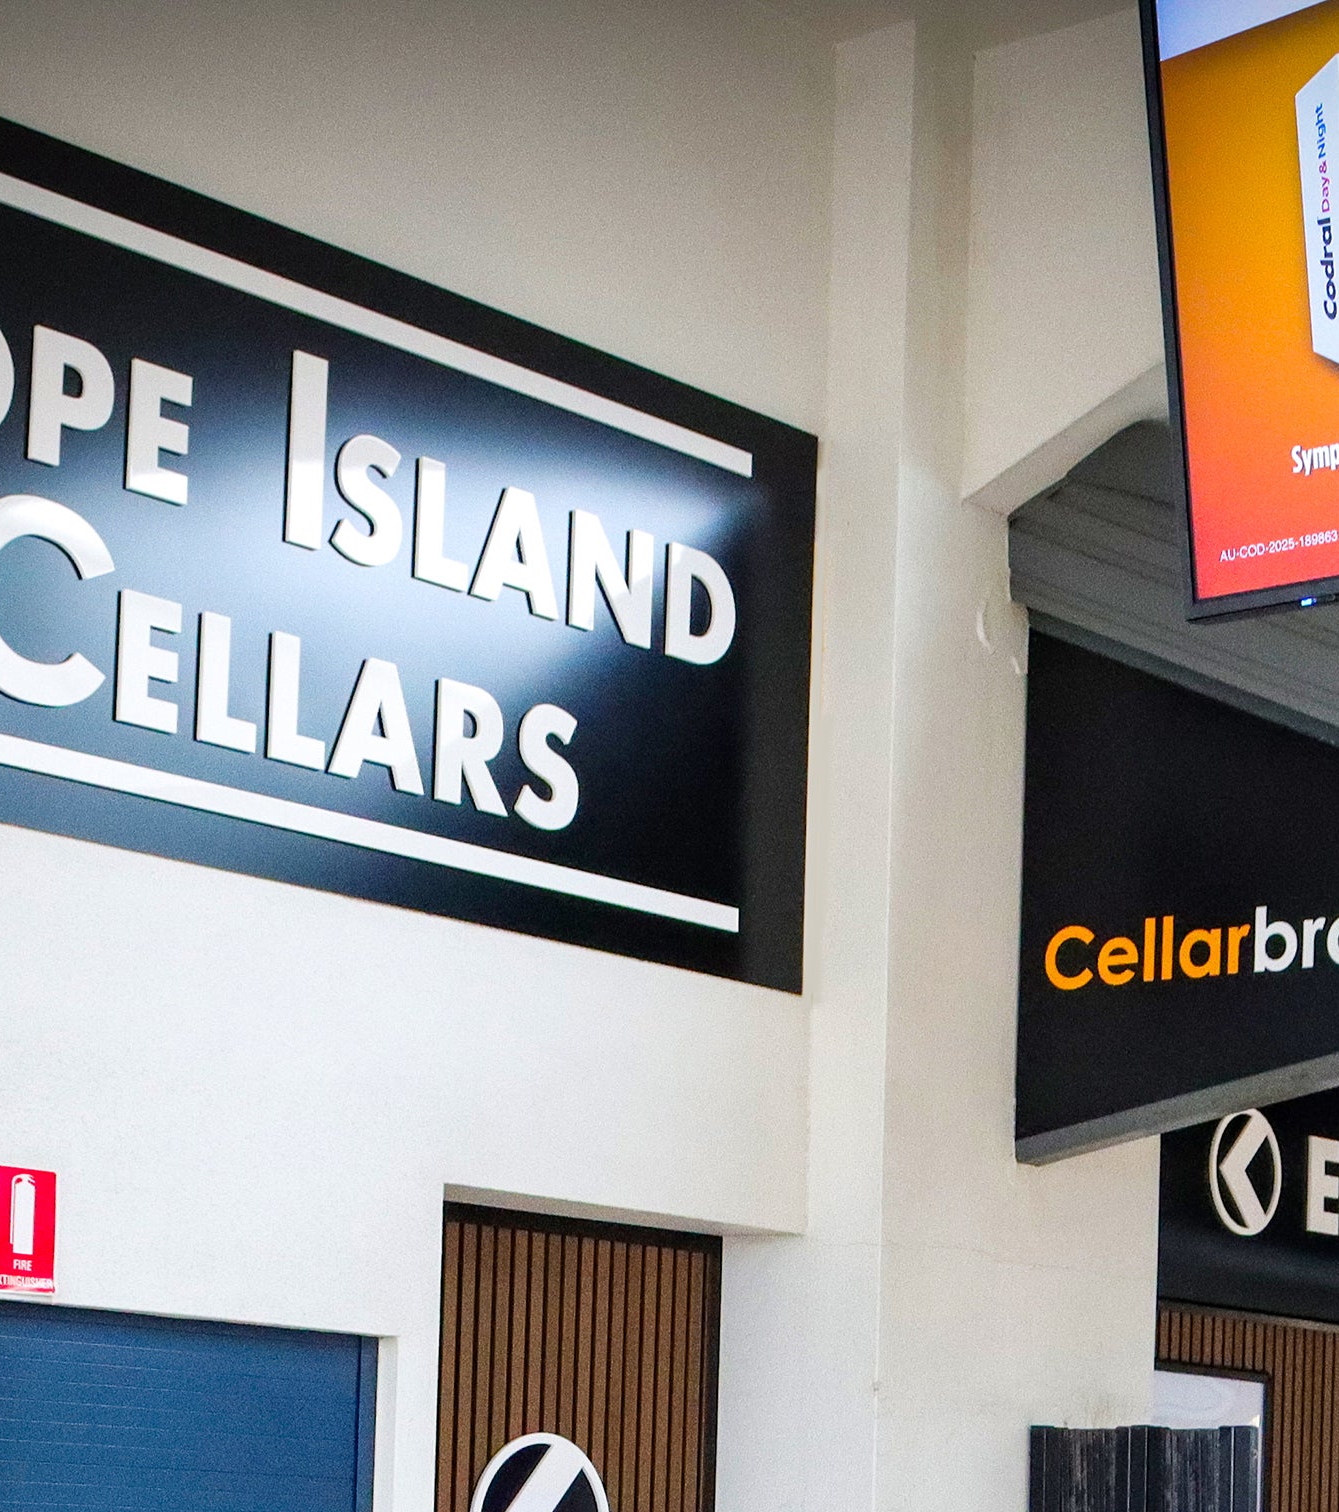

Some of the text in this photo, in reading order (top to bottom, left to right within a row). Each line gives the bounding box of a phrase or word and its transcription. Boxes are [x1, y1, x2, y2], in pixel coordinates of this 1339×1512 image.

[1317, 217, 1337, 320] Codral
[283, 350, 738, 667] ISLAND
[1219, 530, 1339, 563] AU-COD-2025-189863
[13, 1259, 32, 1272] FIRE
